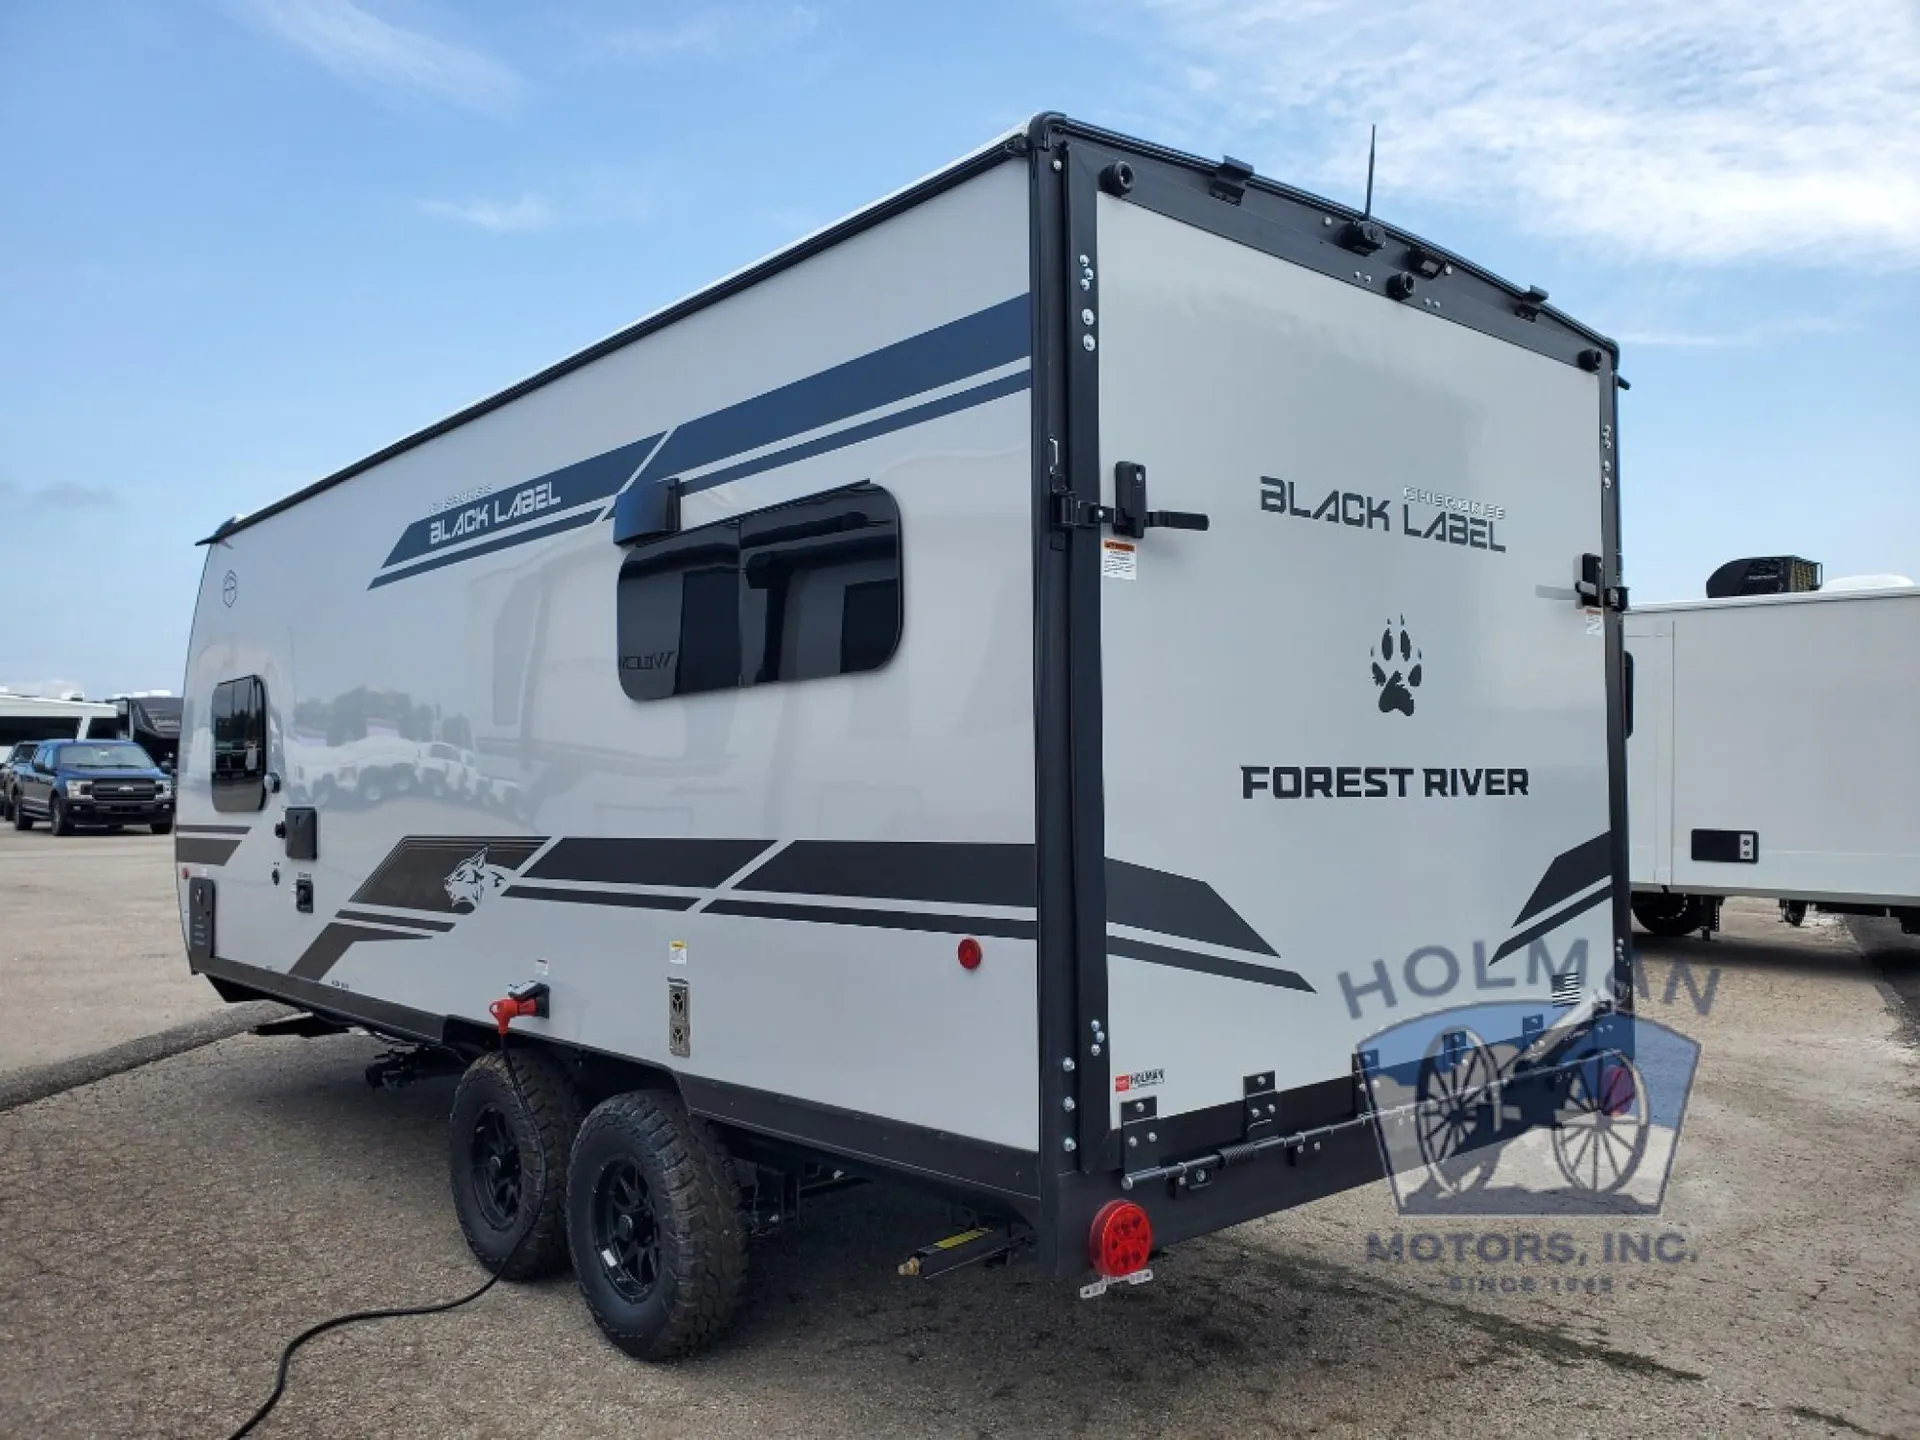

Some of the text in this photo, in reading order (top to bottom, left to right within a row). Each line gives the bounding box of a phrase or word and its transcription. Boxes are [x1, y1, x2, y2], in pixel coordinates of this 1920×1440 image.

[430, 481, 562, 545] BLACK LABEL
[1260, 475, 1506, 553] BLACK LABEL
[1240, 766, 1529, 799] FOREST RIVER
